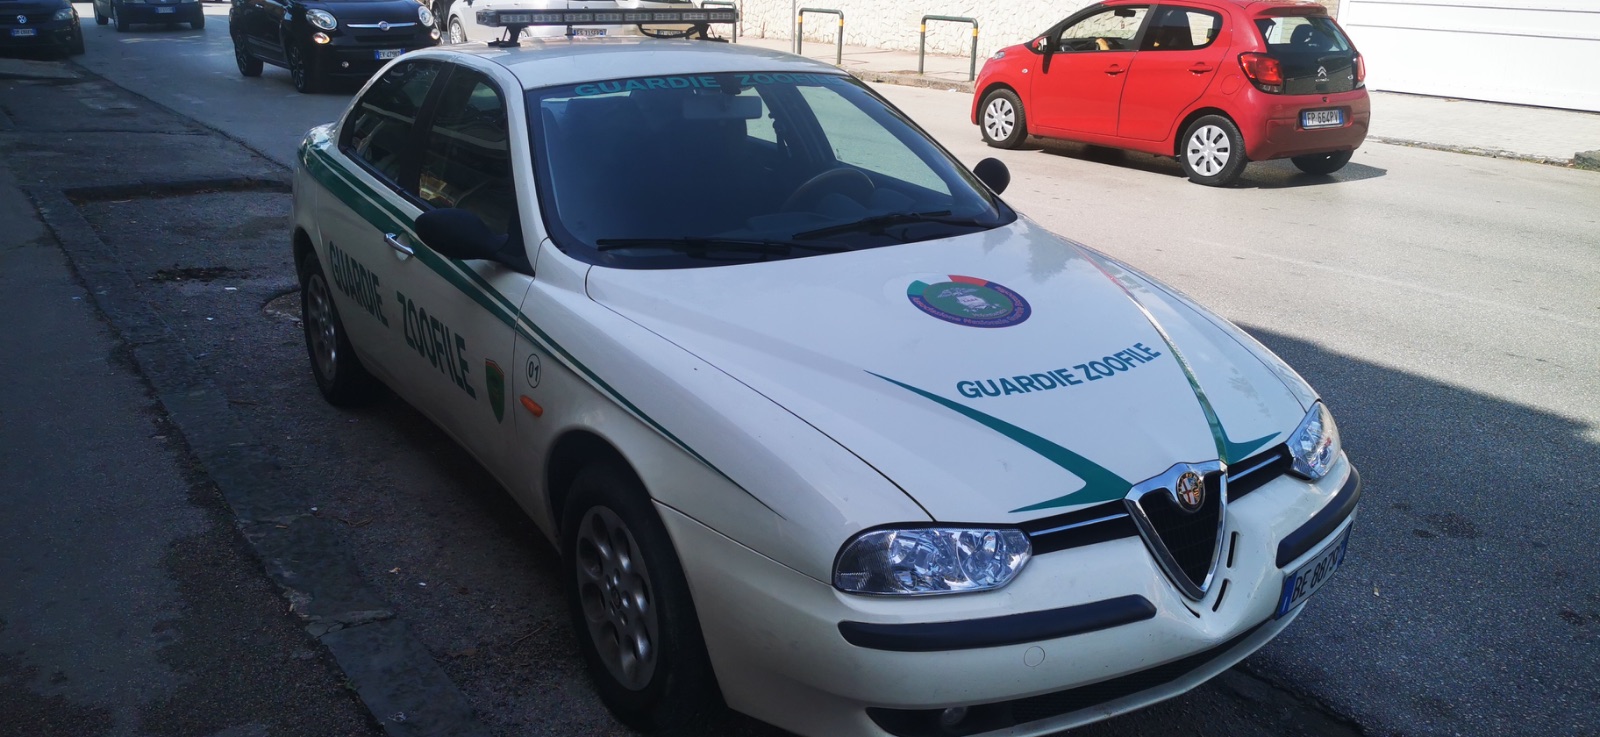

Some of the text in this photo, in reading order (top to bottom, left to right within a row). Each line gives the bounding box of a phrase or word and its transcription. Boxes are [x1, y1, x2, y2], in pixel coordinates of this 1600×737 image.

[574, 73, 845, 97] GUARDIE ZOOFILE
[329, 241, 477, 400] GUARDIE ZOOFILE
[528, 361, 538, 382] 01
[956, 342, 1162, 399] GUARDIE ZOOFILE
[1291, 569, 1312, 603] BE
